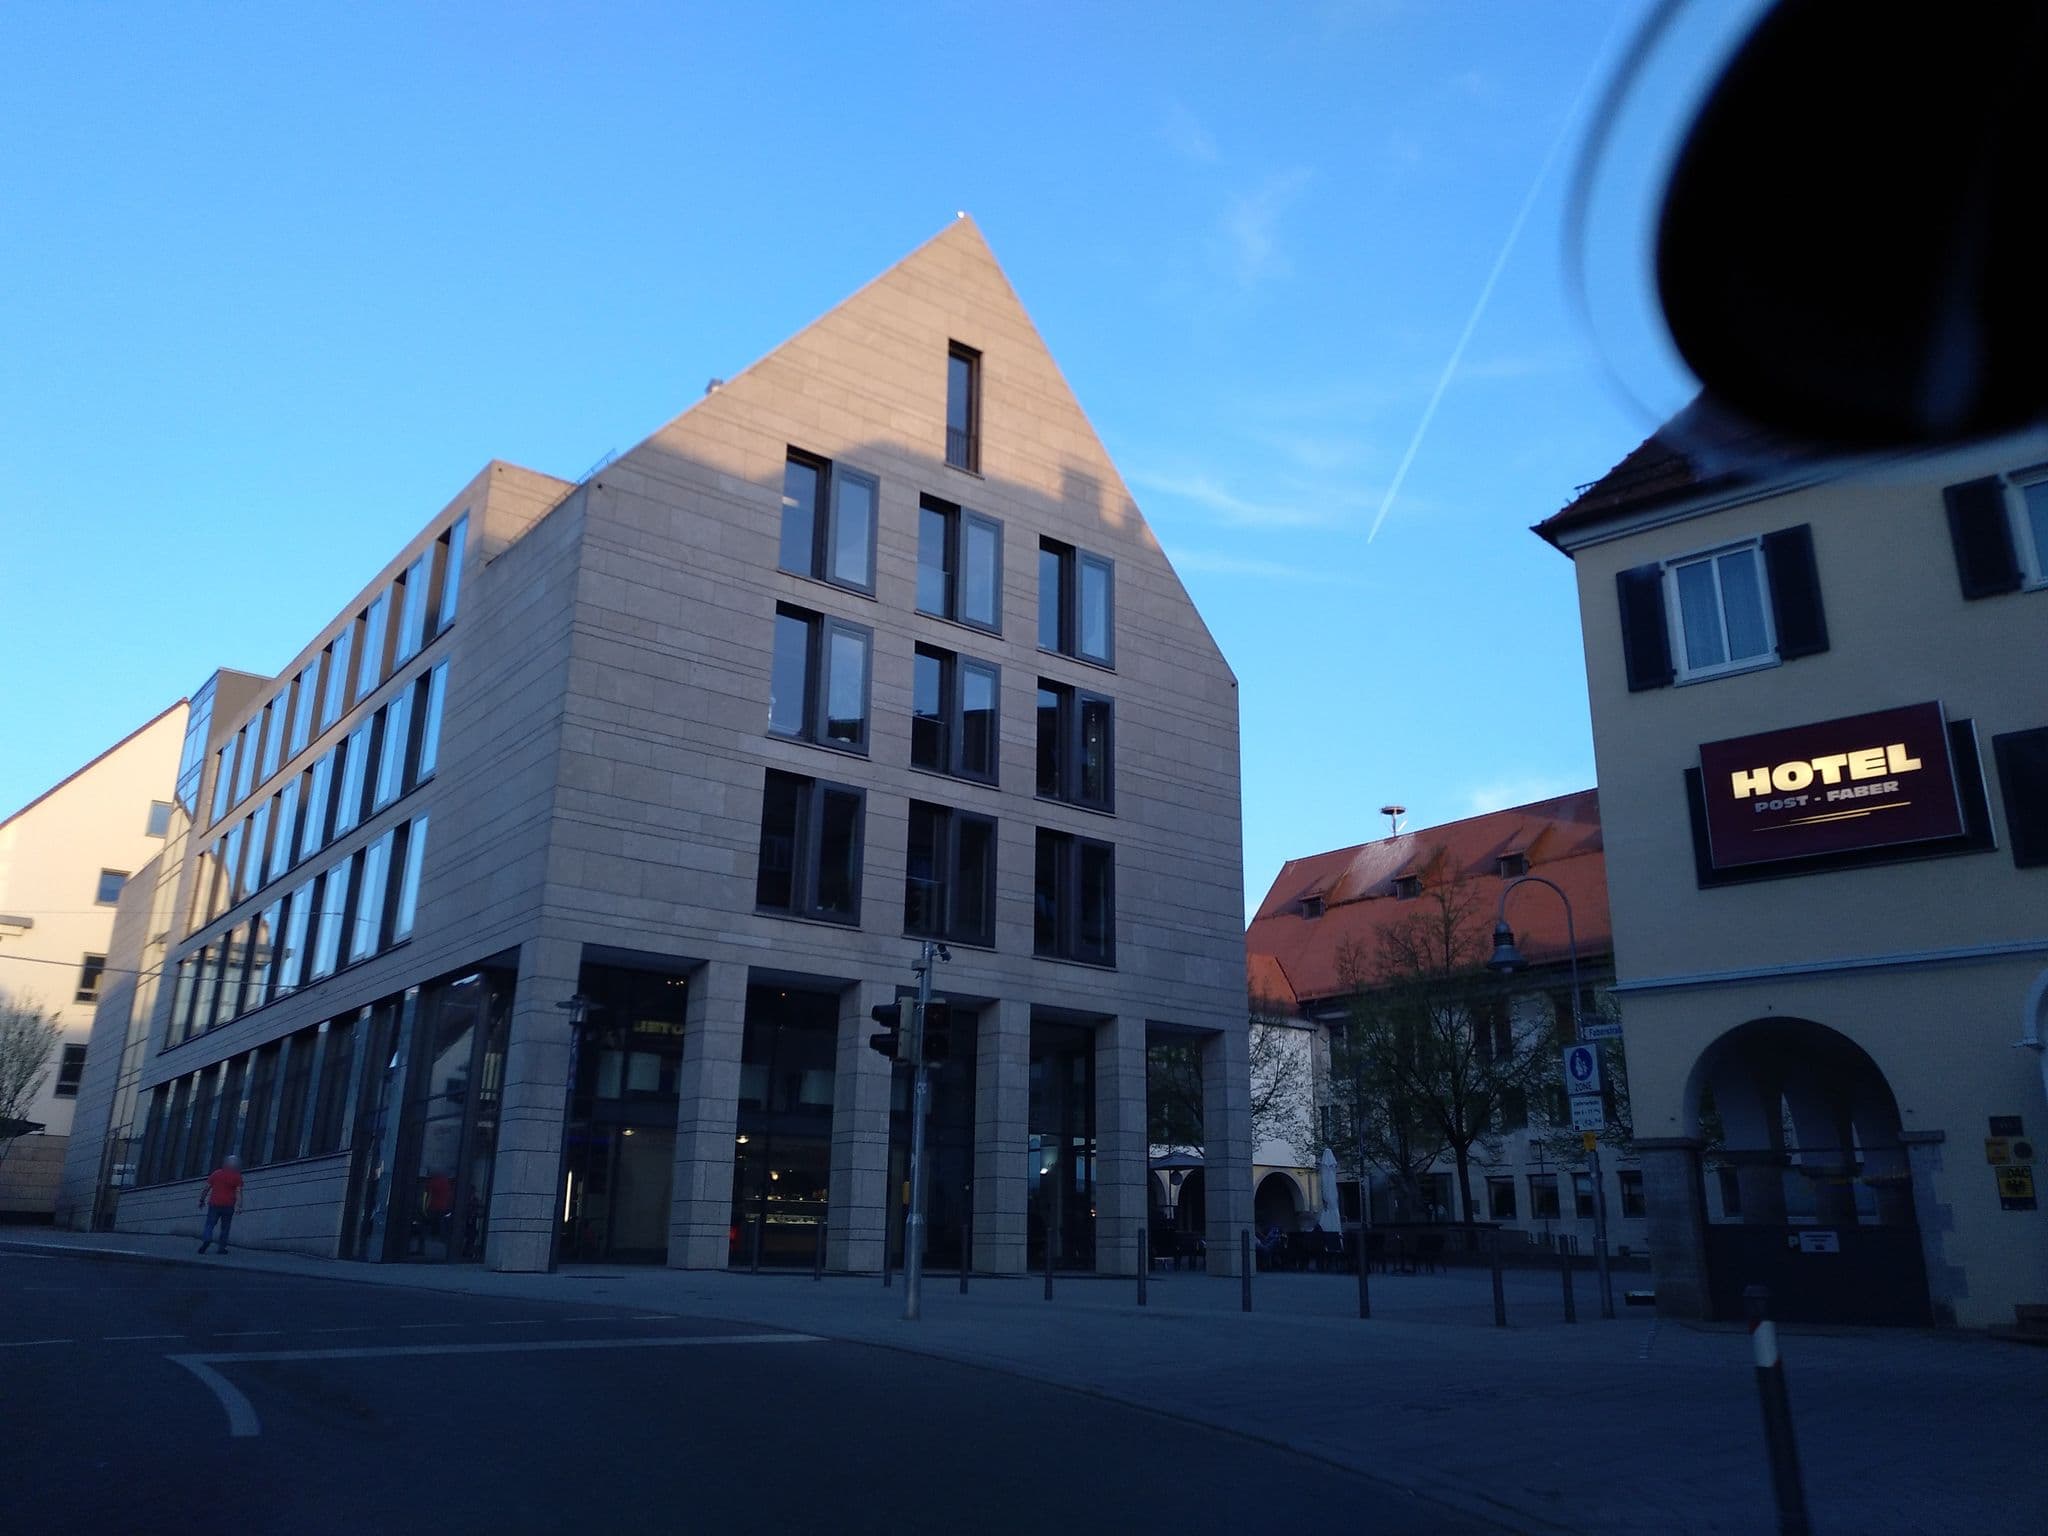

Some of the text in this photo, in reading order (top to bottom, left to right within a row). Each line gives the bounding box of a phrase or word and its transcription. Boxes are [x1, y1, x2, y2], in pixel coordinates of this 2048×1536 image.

[1731, 743, 1922, 799] HOTEL
[1754, 795, 1808, 812] POST
[1827, 781, 1898, 801] FABER
